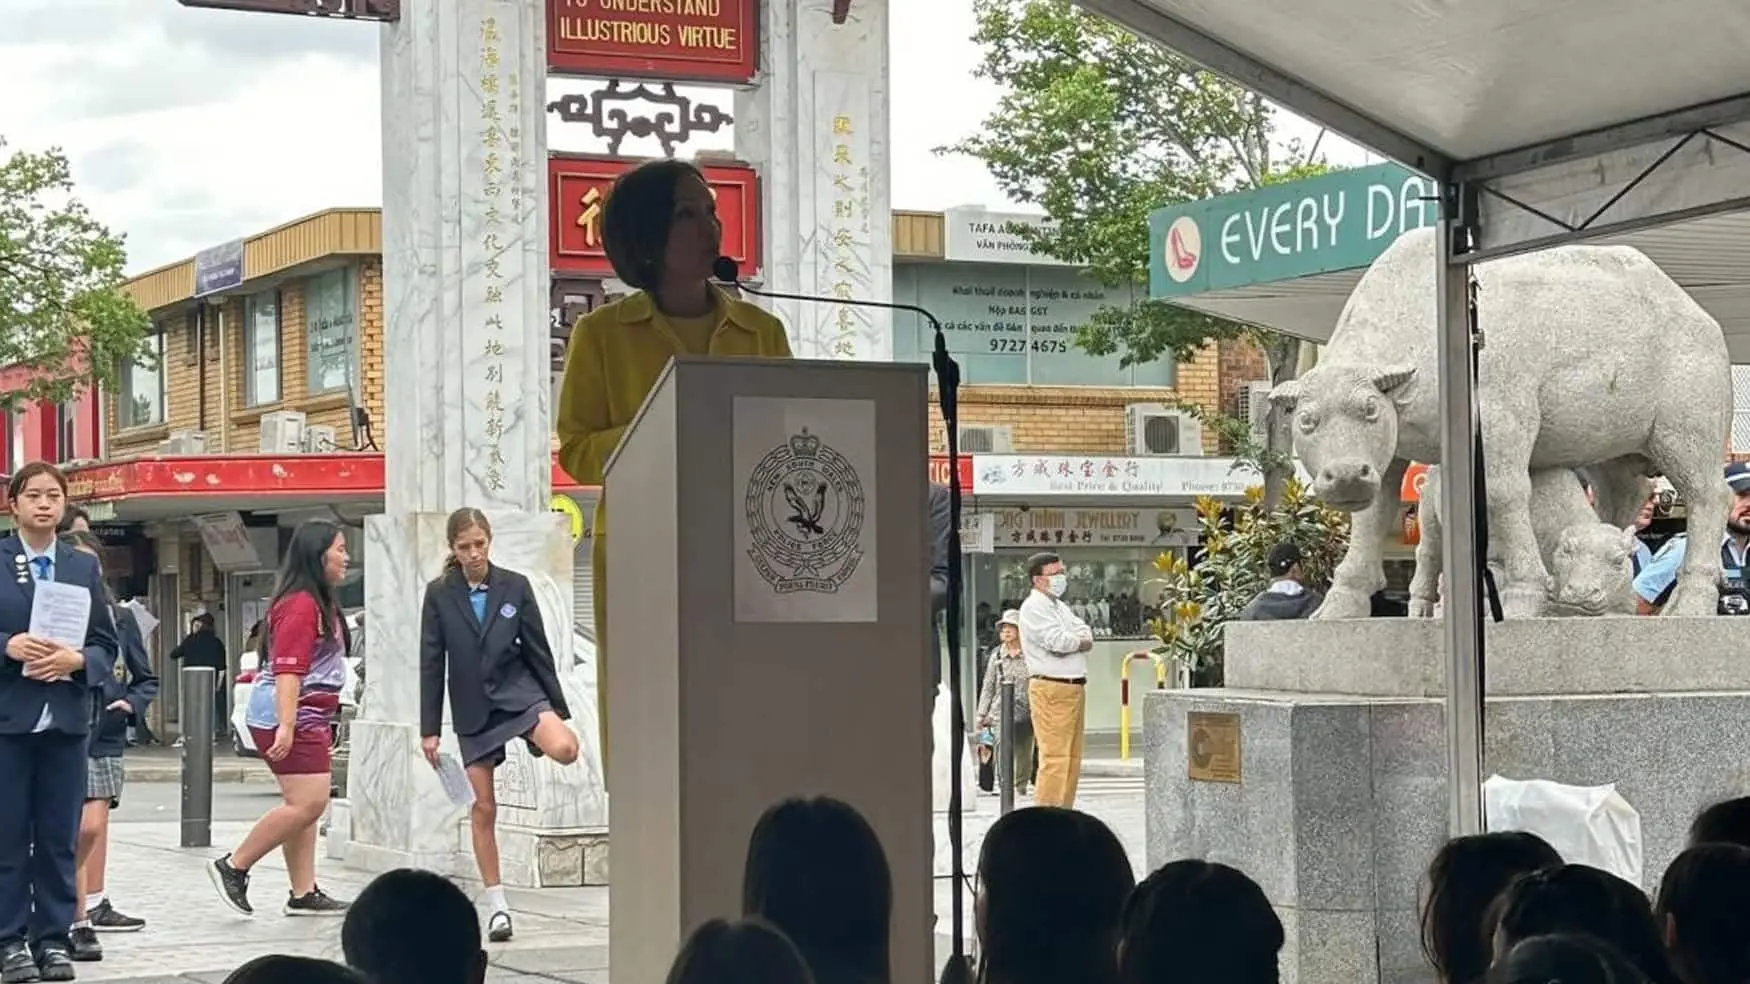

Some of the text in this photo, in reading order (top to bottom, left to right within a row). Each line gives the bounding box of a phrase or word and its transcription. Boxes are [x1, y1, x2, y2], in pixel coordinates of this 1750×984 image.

[560, 17, 737, 49] ILLUSTRIOUS VIRTUE
[1221, 190, 1345, 264] EVERY
[989, 338, 1067, 353] 9727 4675
[1072, 511, 1140, 530] JEWELLERY
